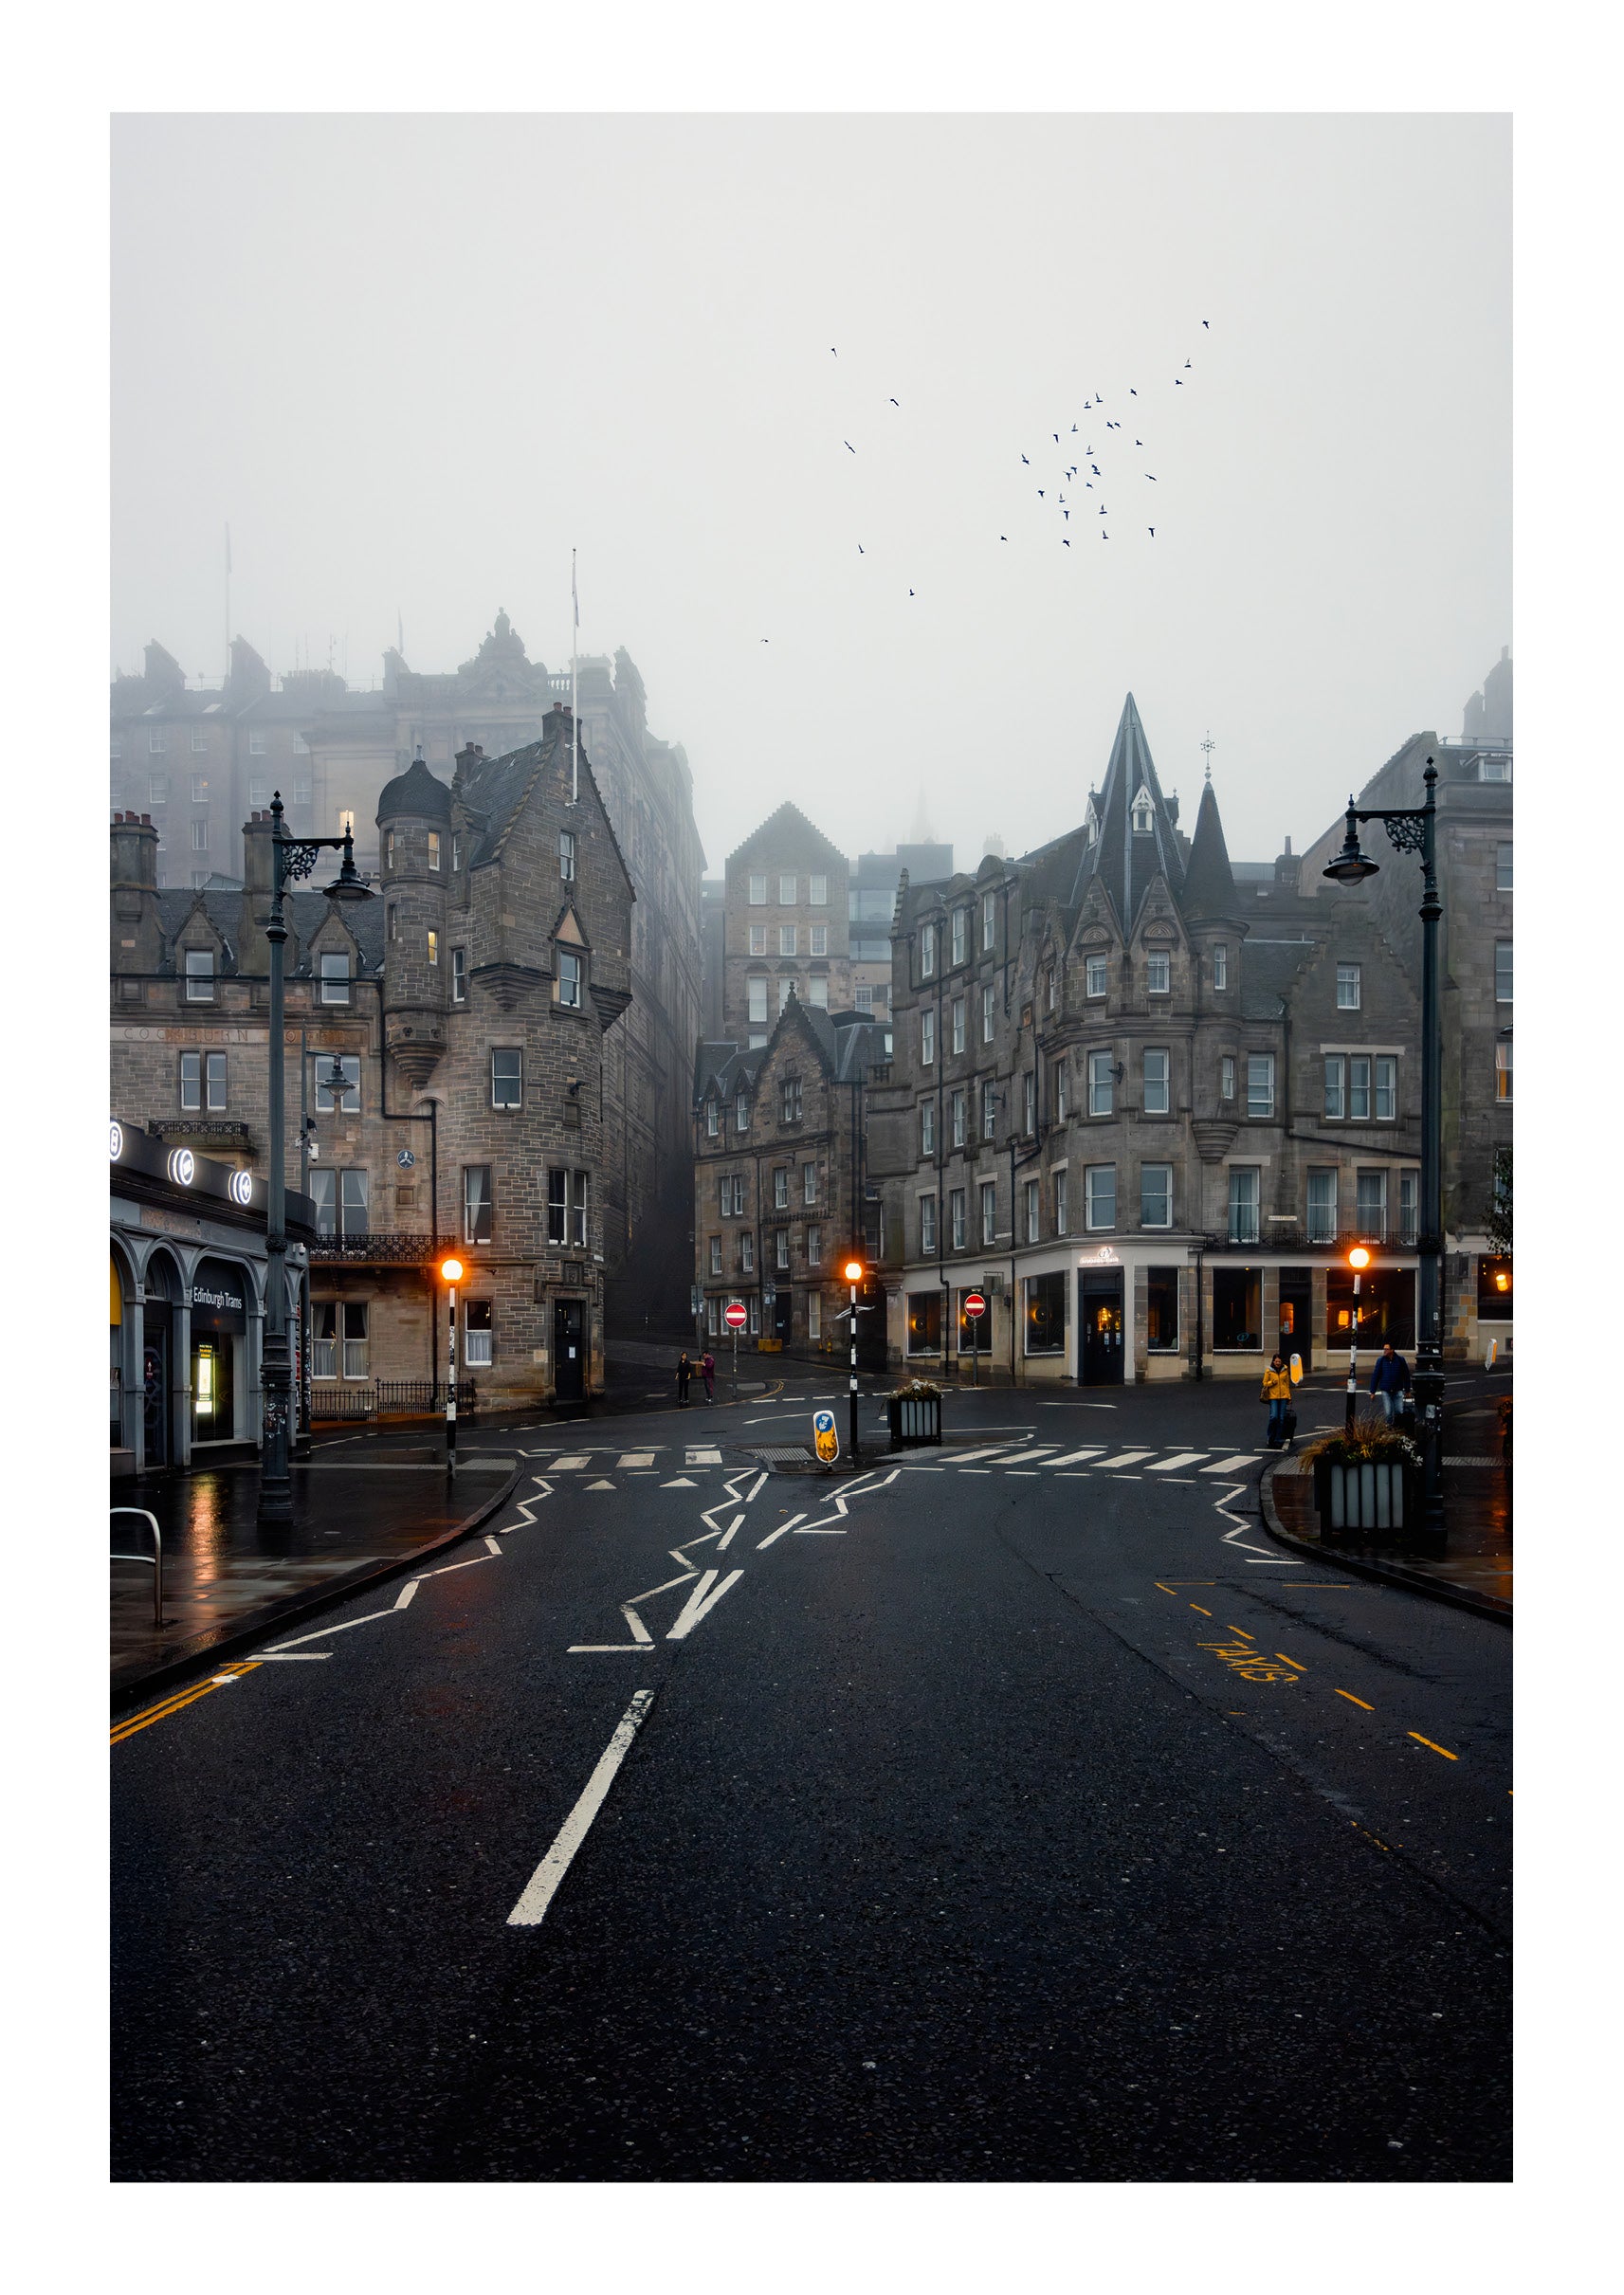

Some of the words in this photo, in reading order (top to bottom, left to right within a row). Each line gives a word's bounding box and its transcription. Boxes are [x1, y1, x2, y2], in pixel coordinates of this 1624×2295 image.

[123, 1028, 248, 1042] COCBURN
[193, 1286, 225, 1308] Edinburgh
[225, 1291, 243, 1309] Trams
[1196, 1640, 1299, 1682] TAXIS
